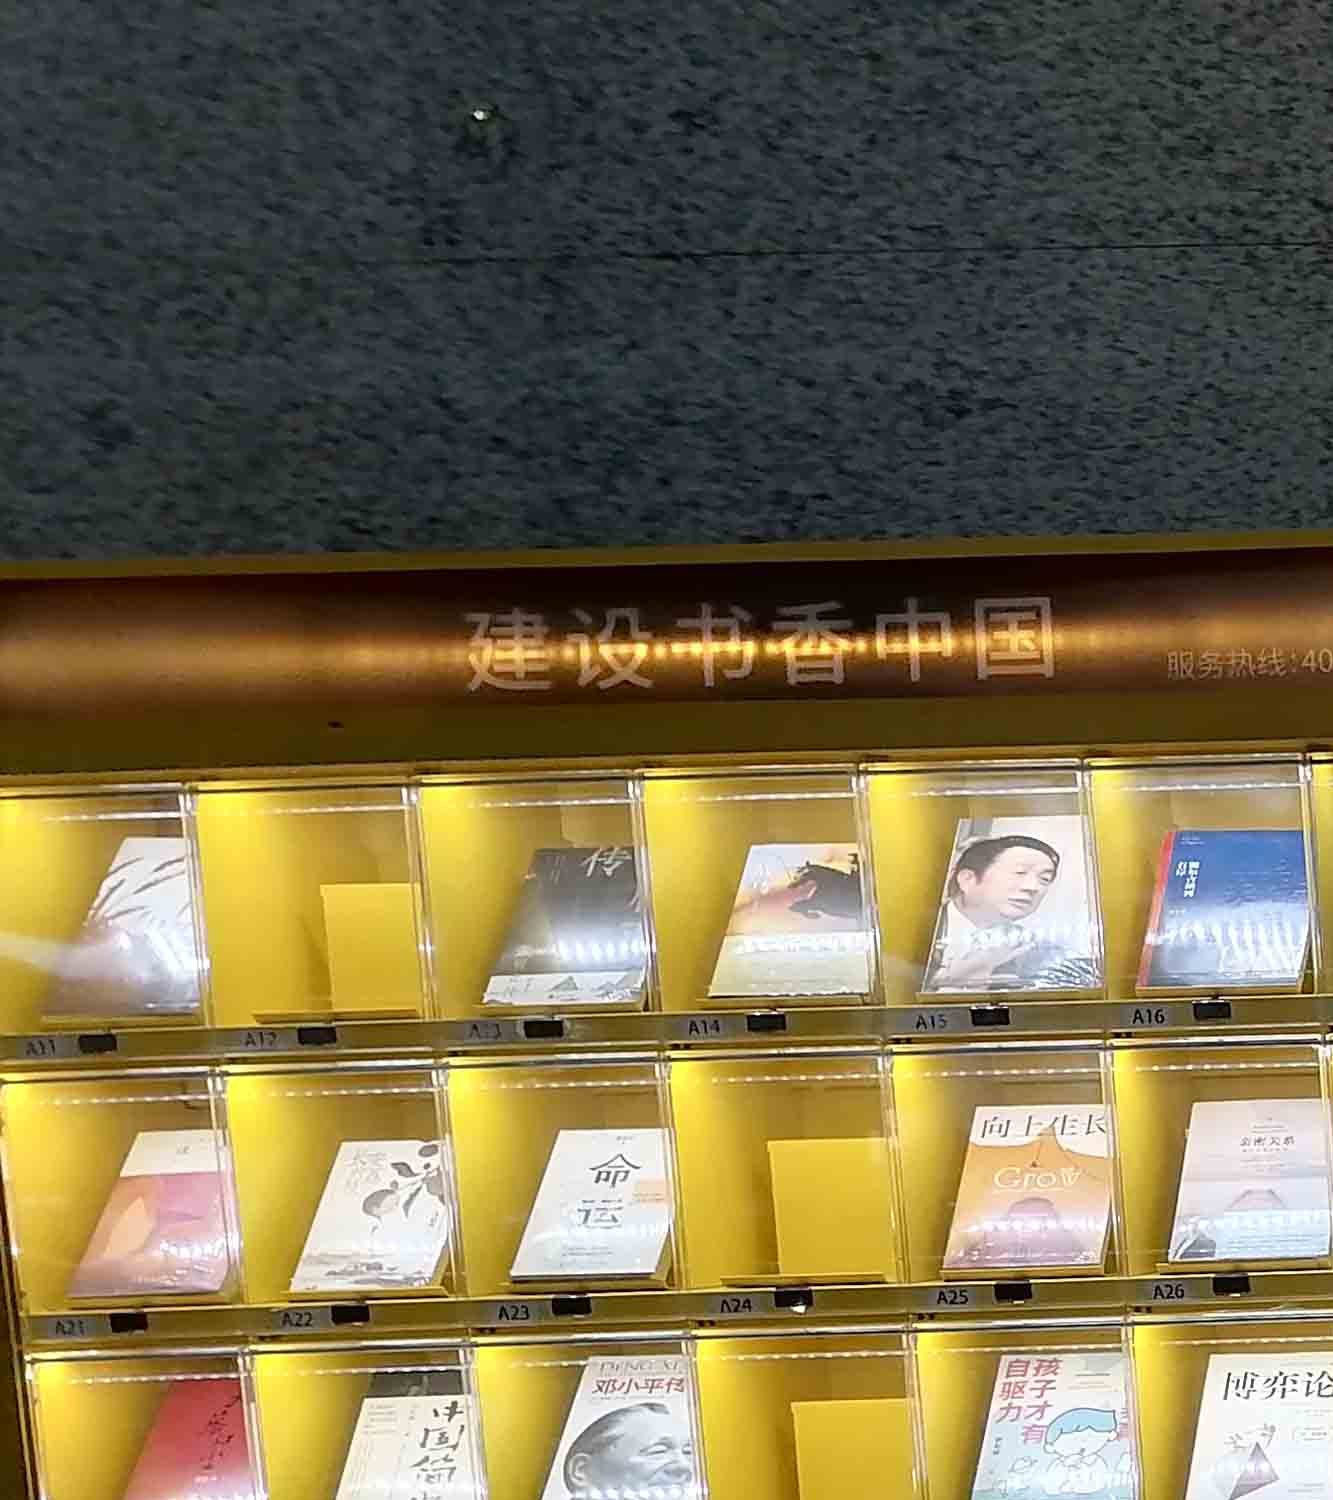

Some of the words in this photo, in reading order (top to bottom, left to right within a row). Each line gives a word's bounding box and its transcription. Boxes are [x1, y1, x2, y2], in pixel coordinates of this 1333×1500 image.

[463, 595, 1055, 693] 建设书香中国
[1132, 1007, 1165, 1025] A16
[577, 1153, 642, 1230] 命运
[936, 1290, 969, 1305] A25
[1152, 1284, 1185, 1300] A26
[591, 1376, 686, 1396] 邓小平传
